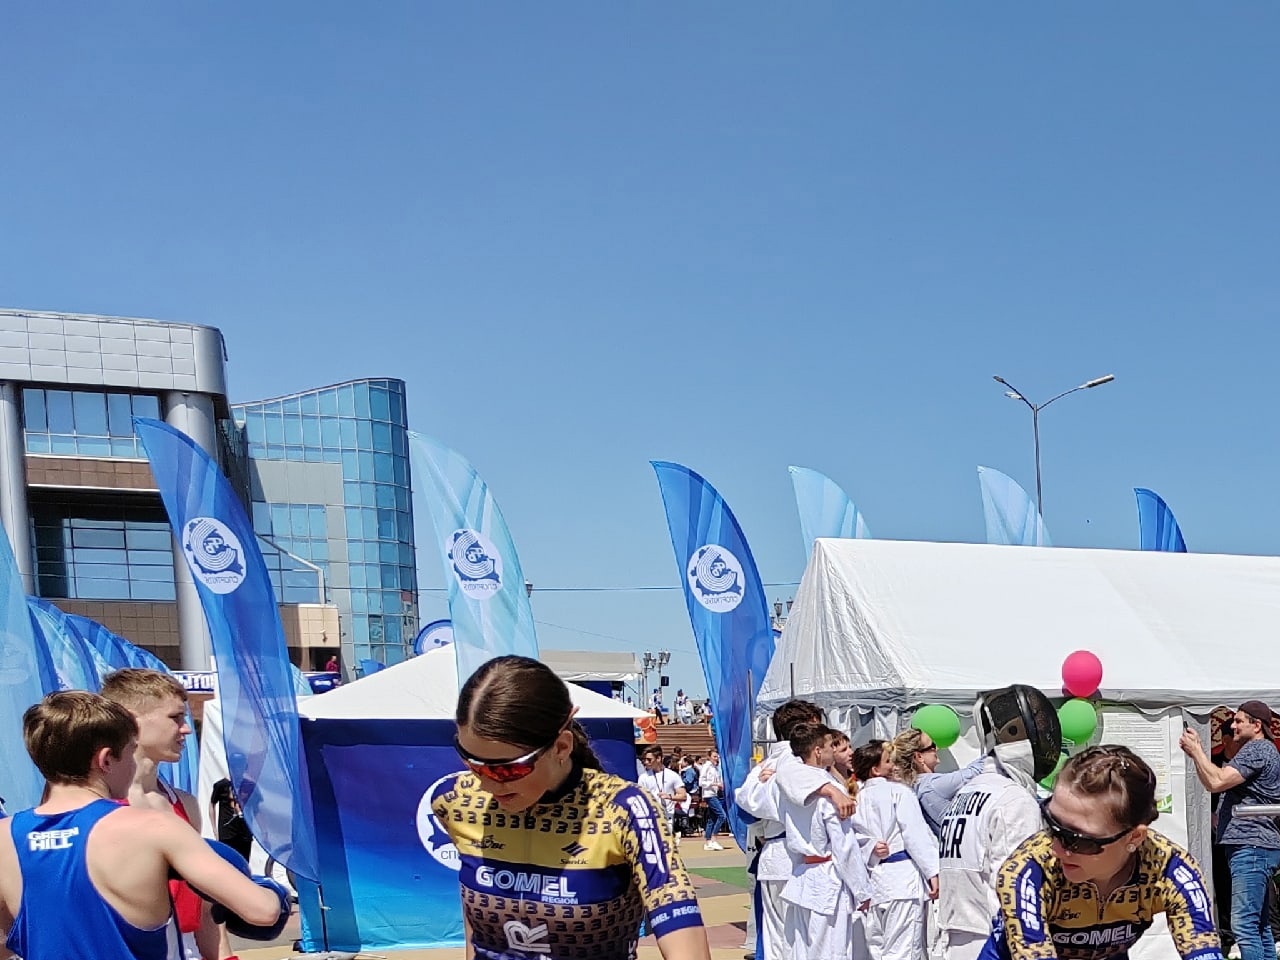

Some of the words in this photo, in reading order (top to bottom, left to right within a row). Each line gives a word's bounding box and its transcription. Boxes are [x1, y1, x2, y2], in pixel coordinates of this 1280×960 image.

[27, 826, 79, 840] GREEN
[29, 838, 73, 851] HILL
[475, 865, 577, 898] GOMEL
[540, 895, 579, 906] REGION
[1052, 924, 1137, 945] GOMEL
